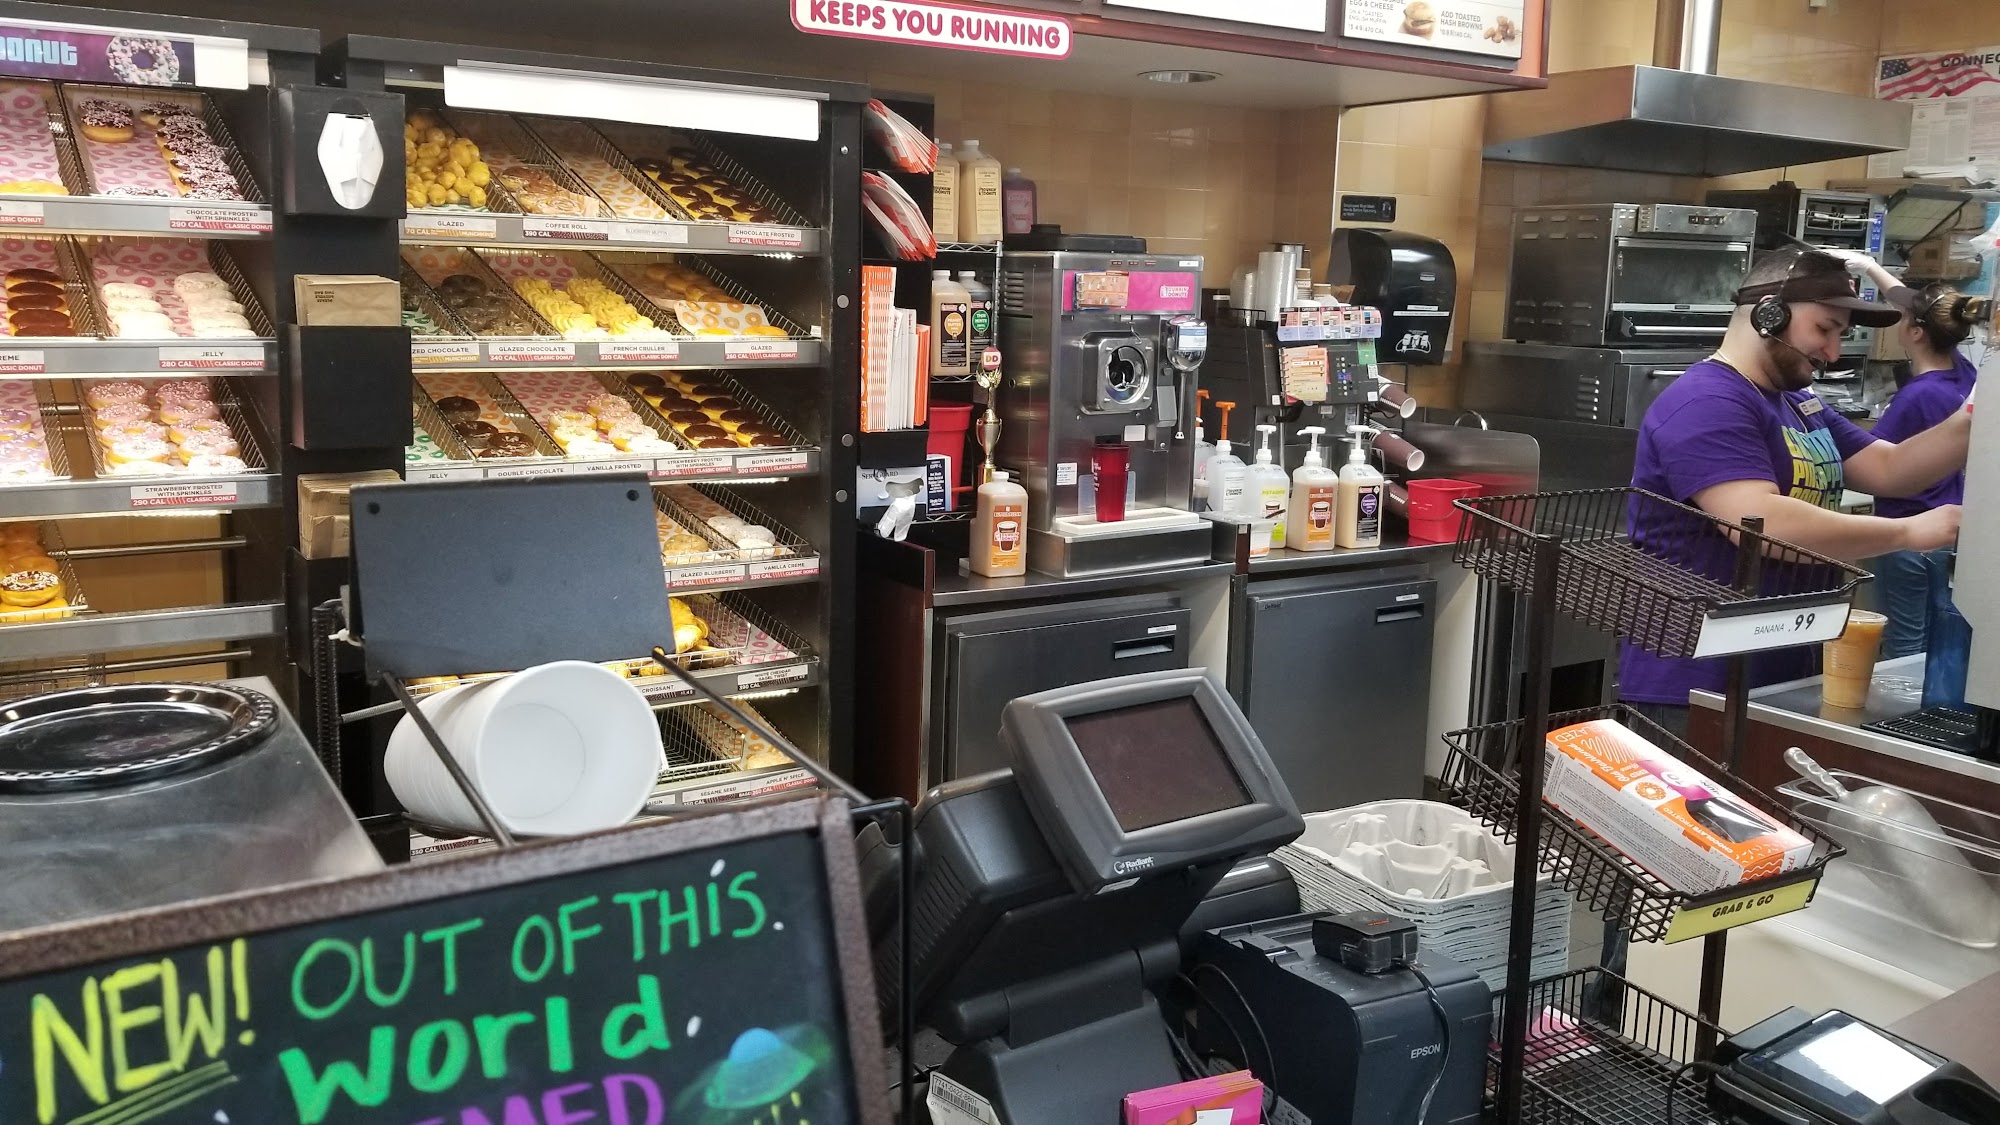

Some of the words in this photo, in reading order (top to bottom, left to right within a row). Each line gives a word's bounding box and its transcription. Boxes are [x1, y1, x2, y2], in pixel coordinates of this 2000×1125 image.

[1363, 10, 1384, 18] TOASTED
[1370, 2, 1394, 11] CHEESE
[1441, 11, 1454, 19] ADD
[1455, 13, 1481, 22] TOASTED
[810, 0, 886, 30] KEEPS
[892, 8, 943, 37] YOU
[951, 16, 1060, 49] RUNNING
[1440, 19, 1457, 27] HASH
[1457, 20, 1483, 30] BROWNS
[1941, 53, 2000, 68] CONNEC
[188, 221, 204, 229] CAL
[545, 222, 570, 230] COFFEE
[1754, 623, 1785, 635] BANANA
[1788, 613, 1816, 632] .99
[641, 684, 674, 693] CROISSANT
[1567, 743, 1615, 775] Fashioned
[1610, 768, 1630, 783] Old
[1662, 807, 1693, 830] FROSTED
[1693, 825, 1733, 855] CHOCOLATE
[411, 848, 423, 856] 350
[424, 845, 439, 853] CAL
[1125, 856, 1154, 869] Radiant
[1712, 901, 1744, 918] GRAB
[1745, 901, 1753, 909] &
[1756, 893, 1775, 907] GO
[291, 917, 485, 1020] OUT
[511, 895, 604, 984] OF
[612, 870, 767, 963] THIS
[32, 937, 256, 1125] NEW!
[1410, 1043, 1441, 1060] EPSON
